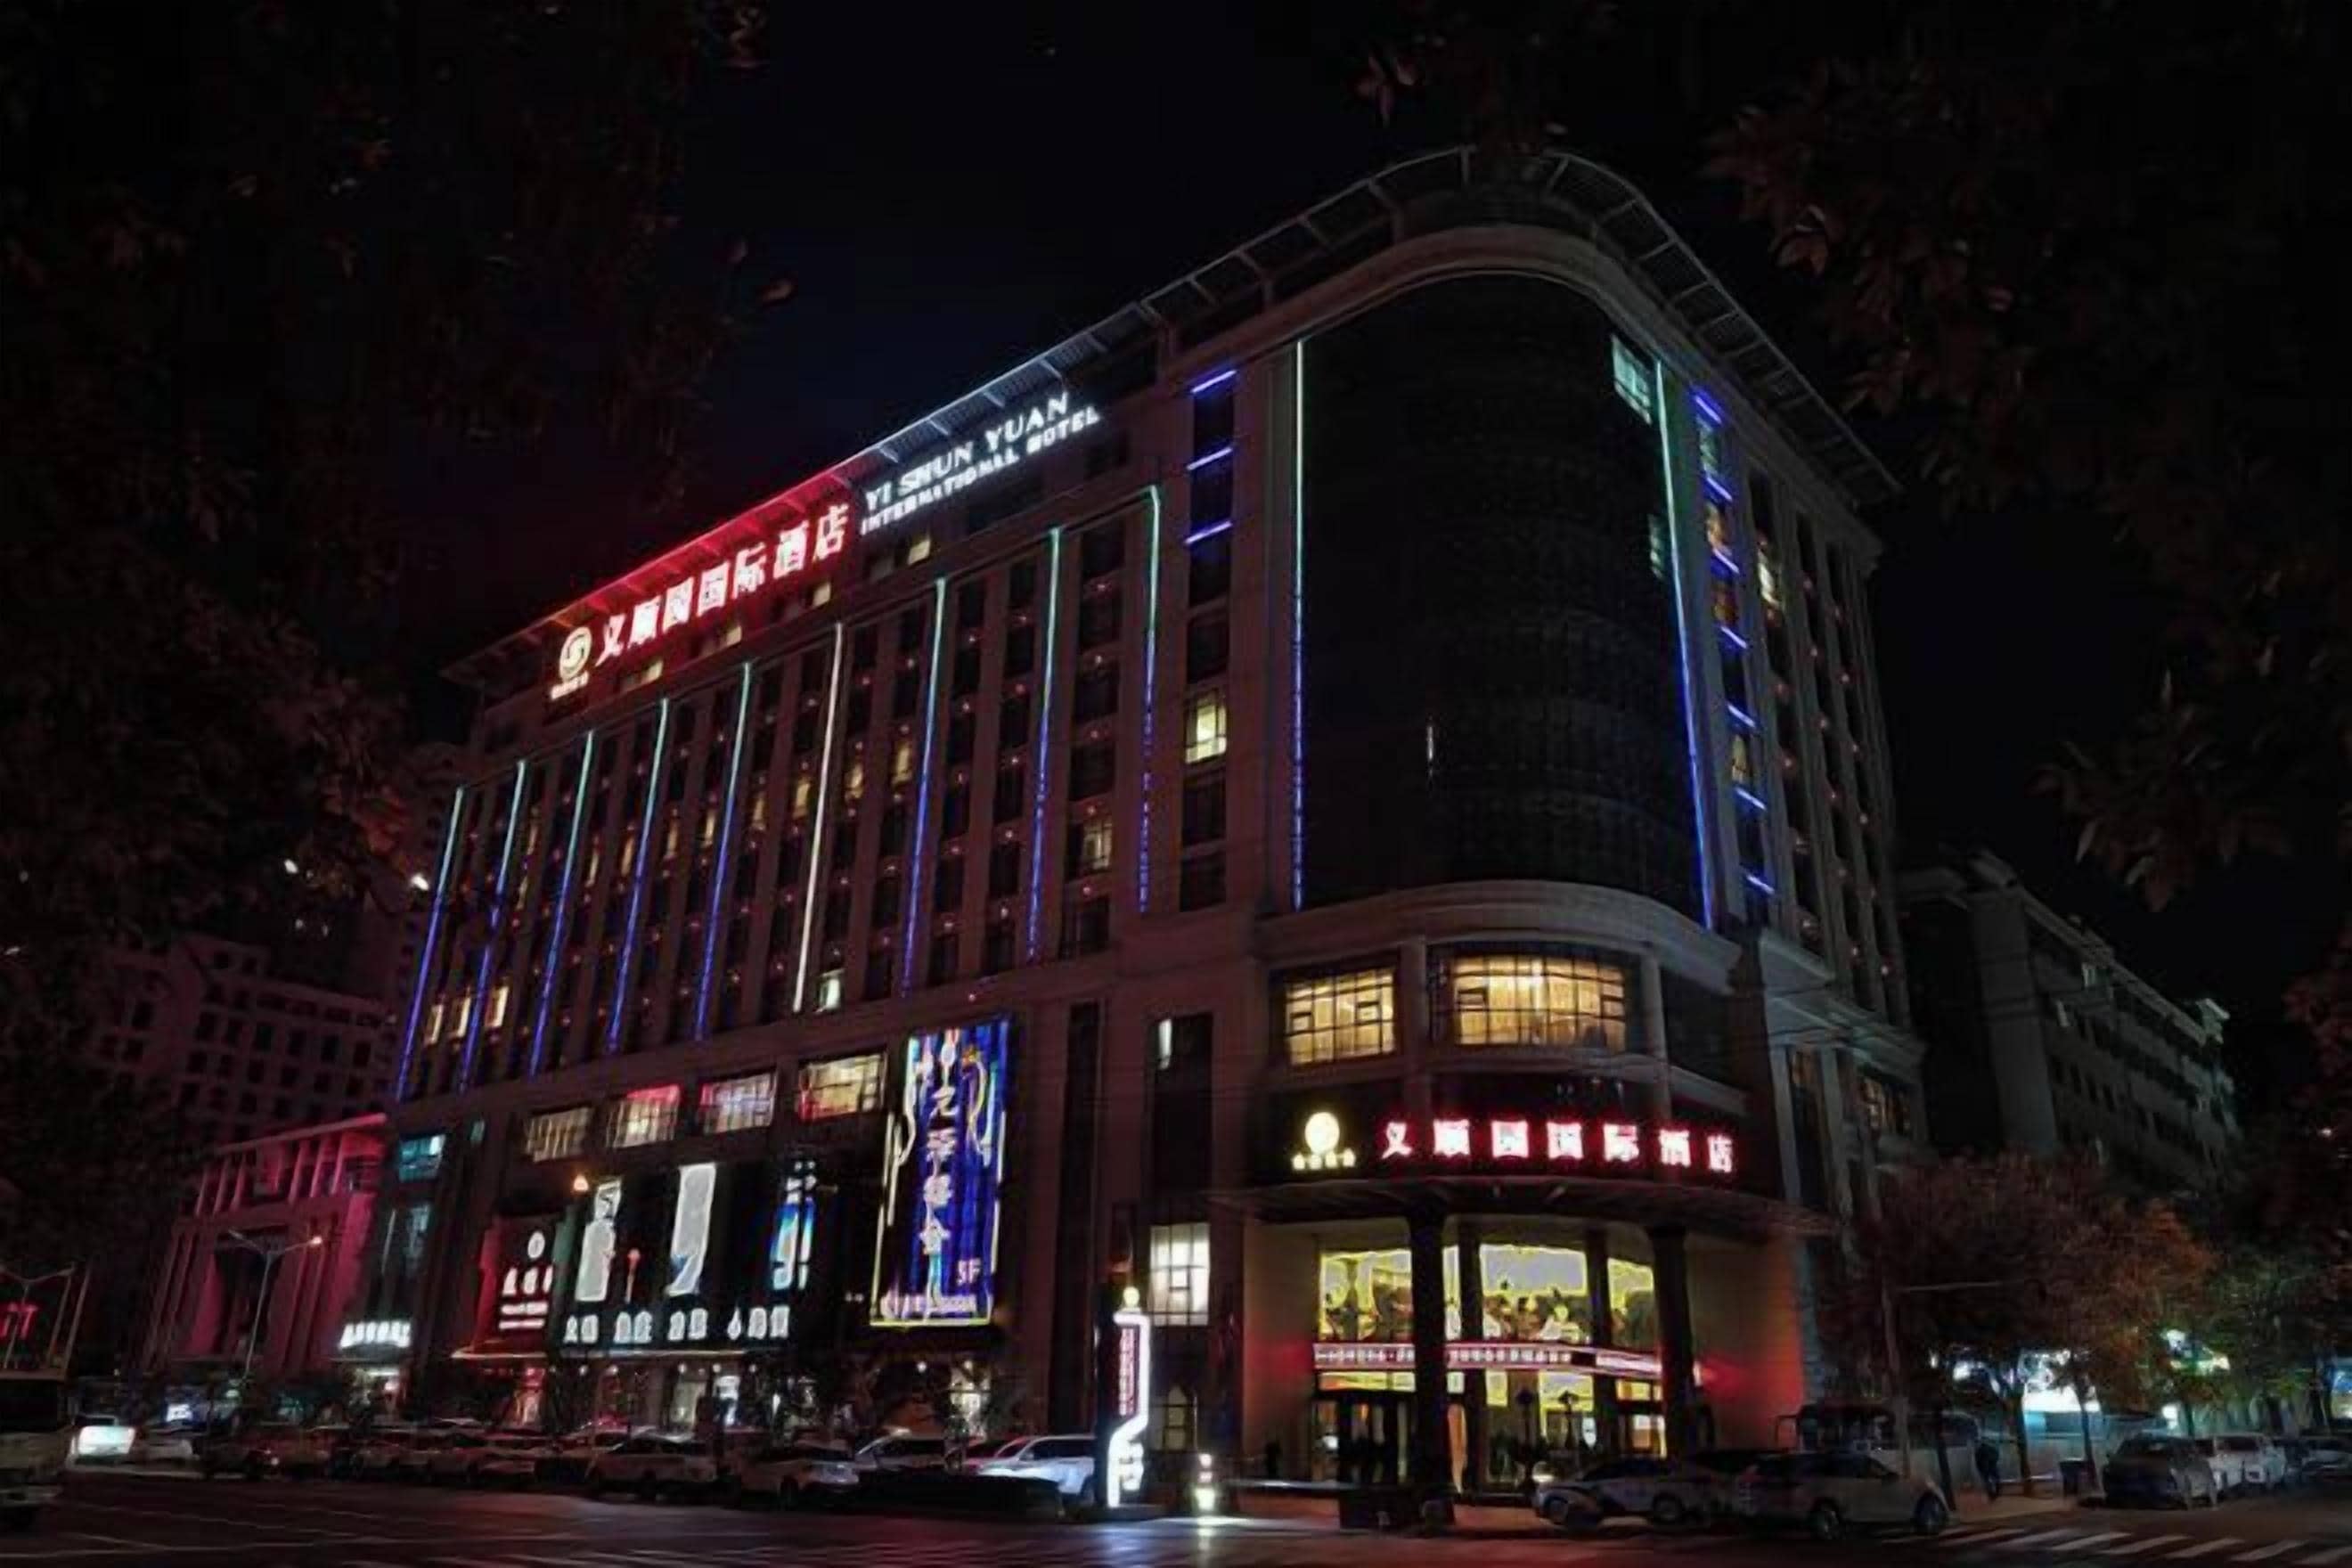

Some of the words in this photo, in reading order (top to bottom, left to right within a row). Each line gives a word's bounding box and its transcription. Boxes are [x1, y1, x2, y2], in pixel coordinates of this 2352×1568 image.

[860, 447, 1021, 535] INTERNATIONAL
[1025, 405, 1102, 455] HOTEL
[865, 479, 893, 511] YI
[898, 440, 974, 495] SHUN
[984, 390, 1070, 452] YUAN
